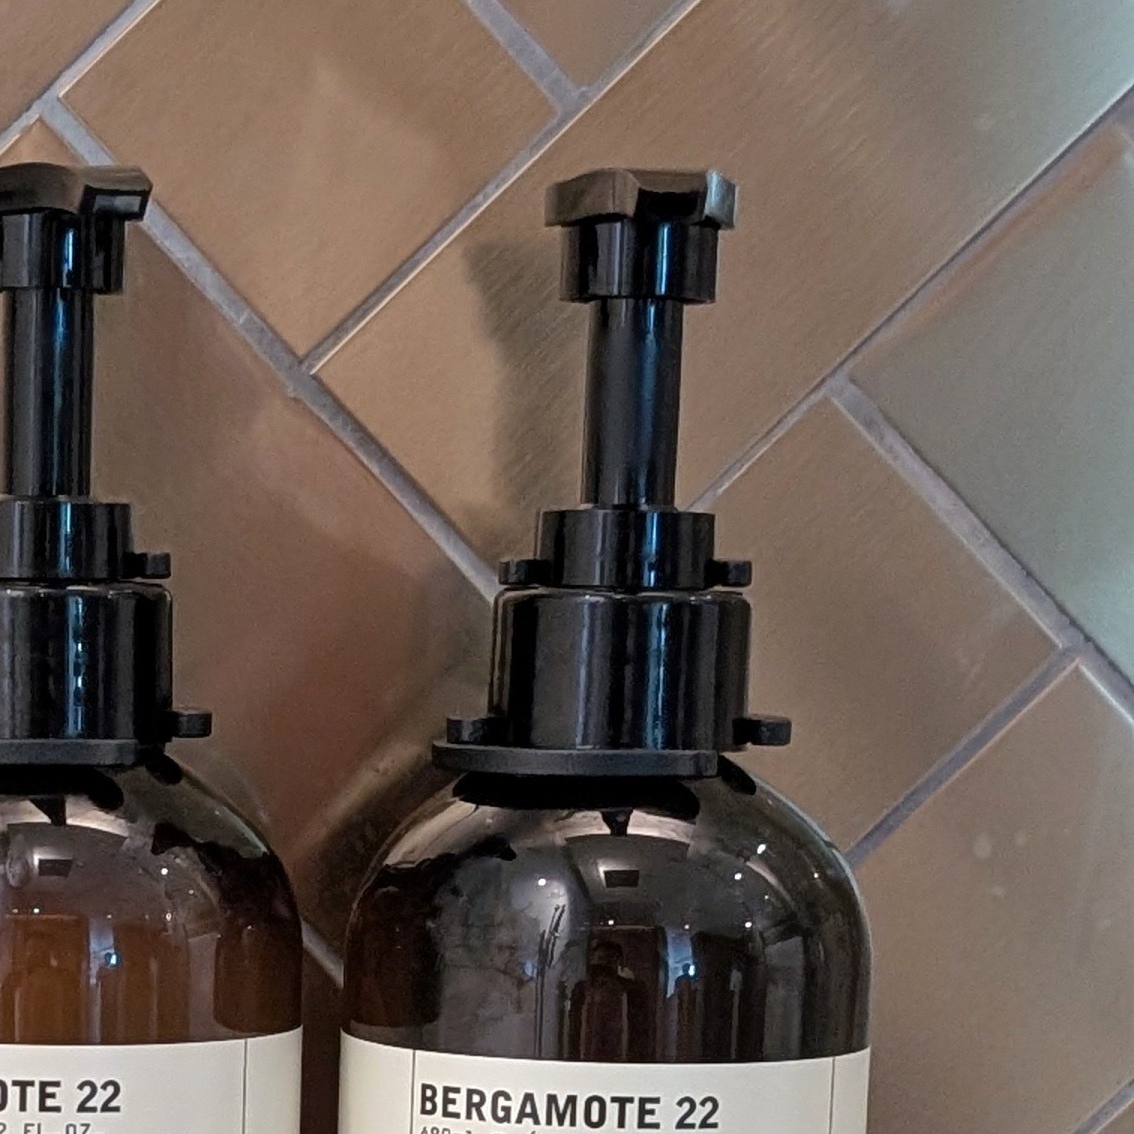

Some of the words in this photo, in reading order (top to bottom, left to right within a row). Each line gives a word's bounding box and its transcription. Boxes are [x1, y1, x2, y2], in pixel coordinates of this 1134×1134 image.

[76, 1079, 121, 1114] 22
[420, 1082, 661, 1130] BERGAMOTE
[675, 1096, 719, 1130] 22
